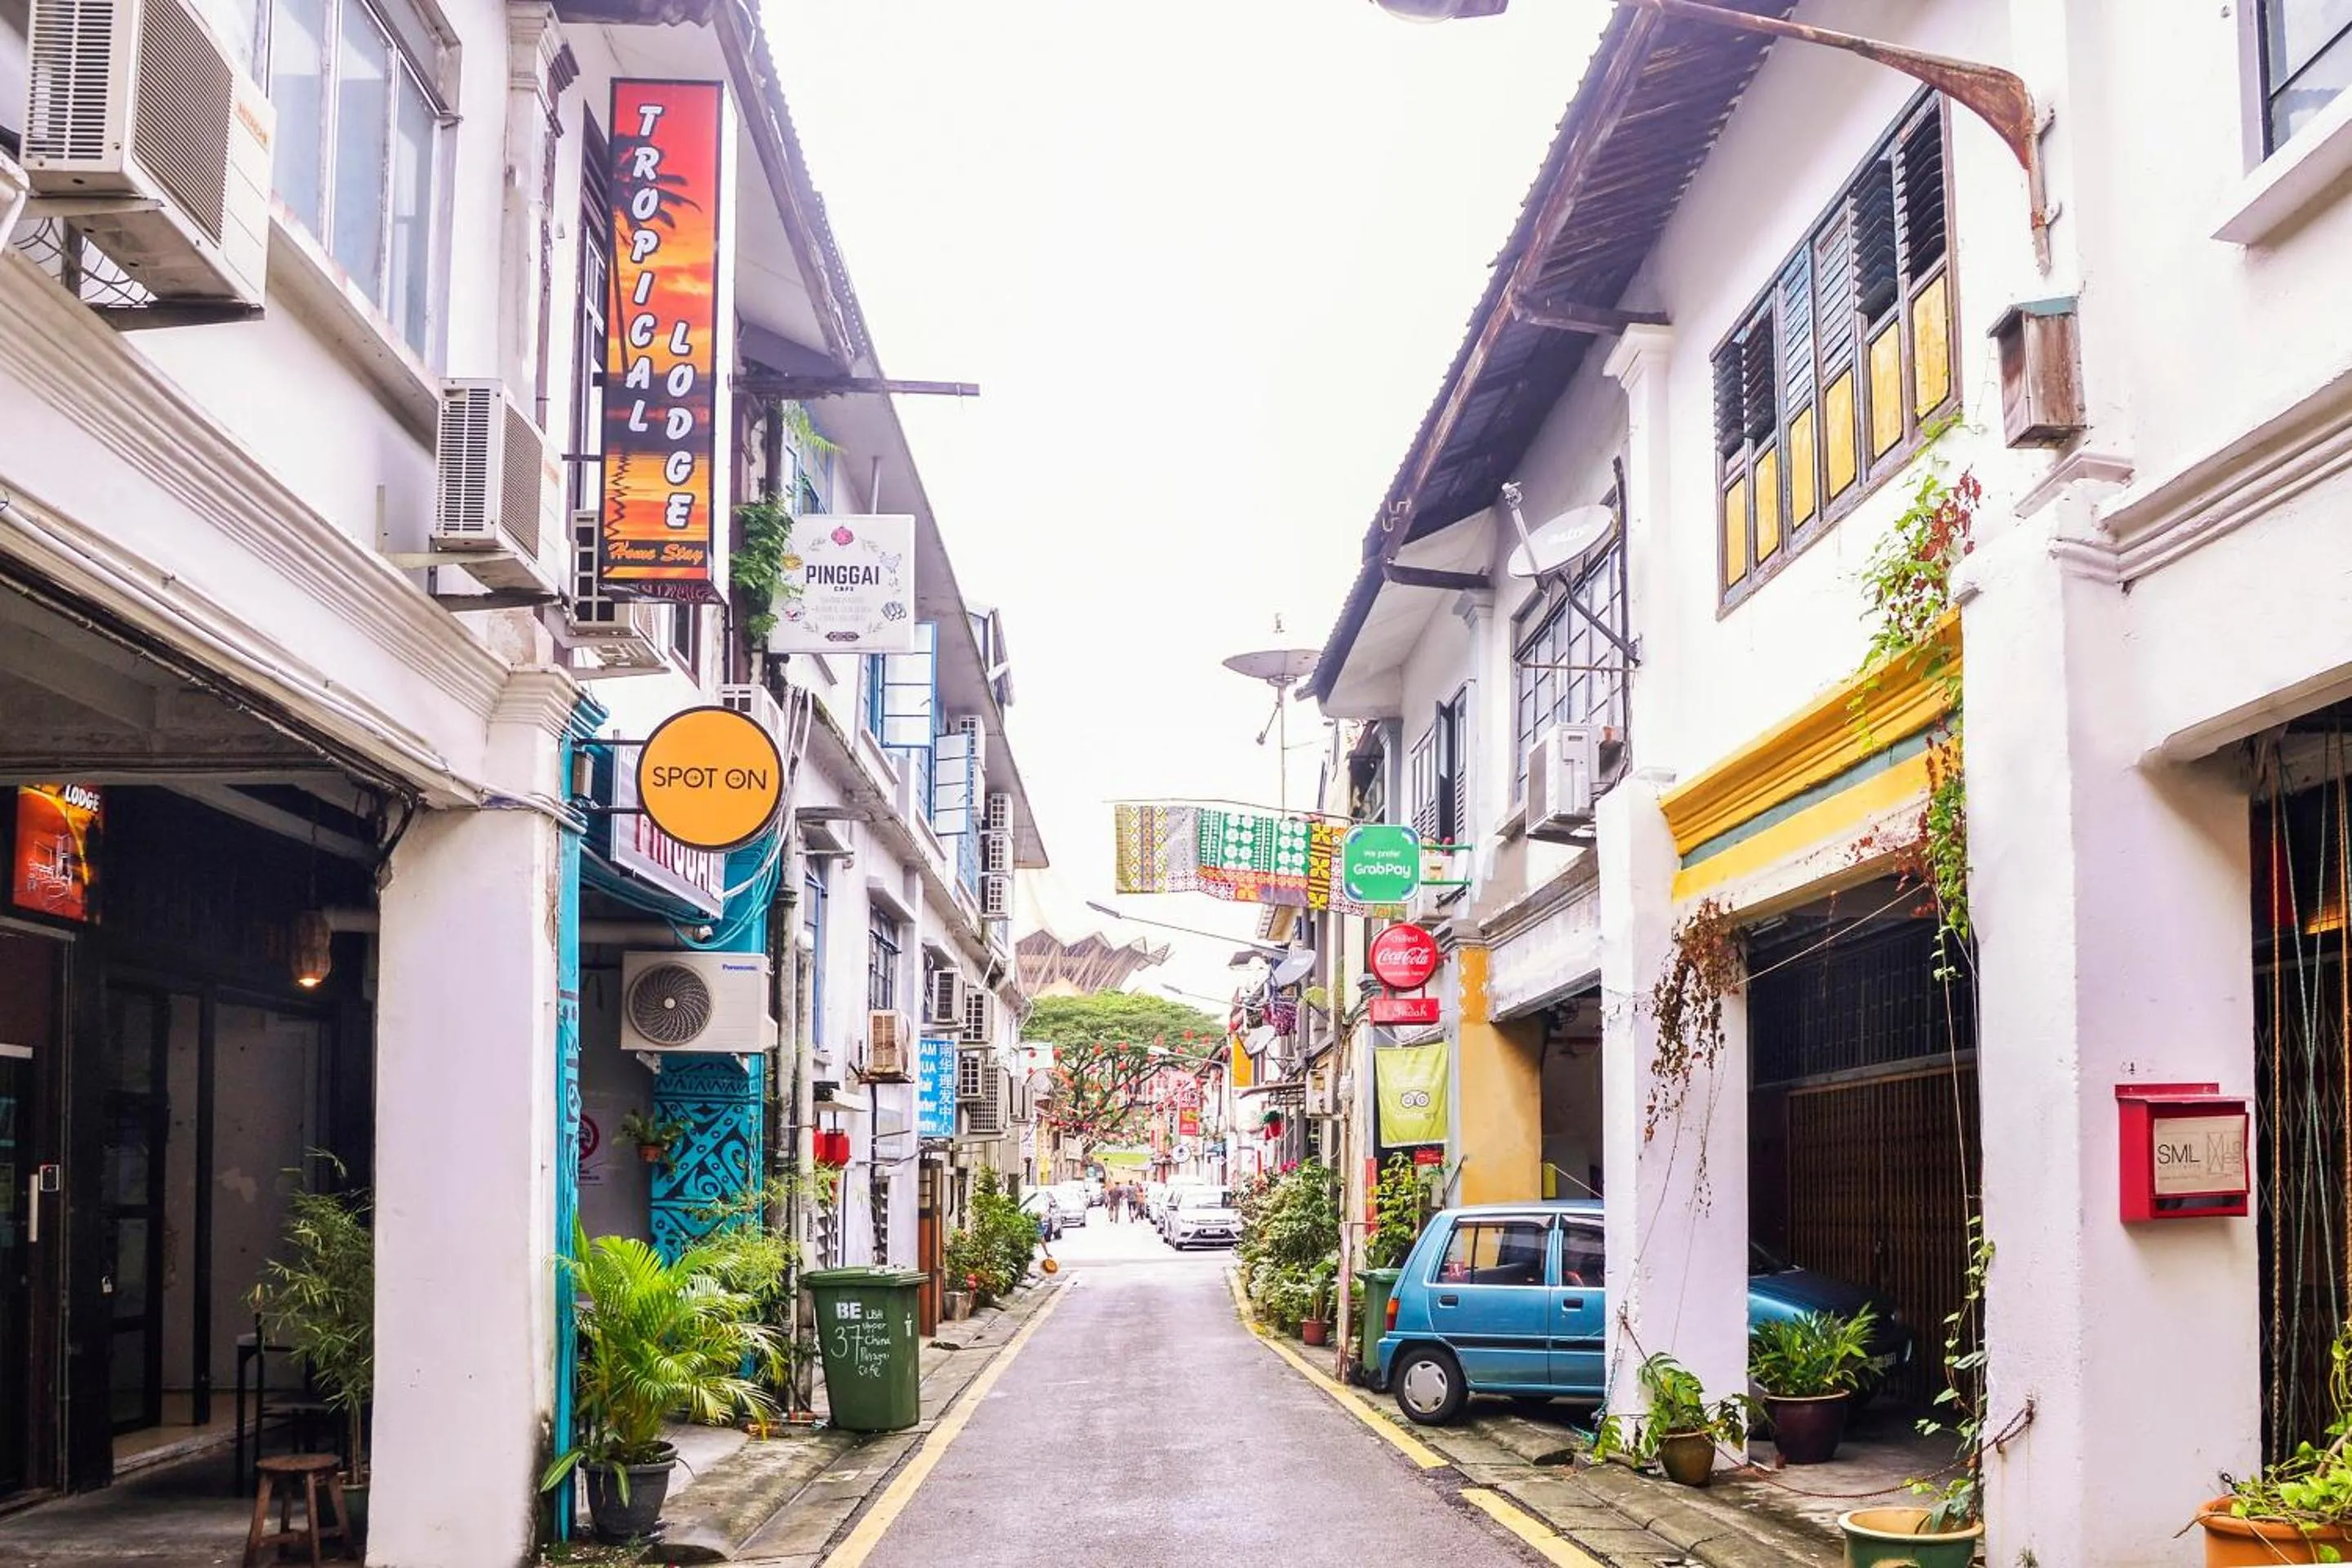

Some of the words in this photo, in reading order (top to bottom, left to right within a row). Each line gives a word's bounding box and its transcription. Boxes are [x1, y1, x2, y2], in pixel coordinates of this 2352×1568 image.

[625, 105, 663, 432] TROPICAL
[666, 322, 694, 527] LODGE
[608, 541, 656, 560] Home
[660, 542, 703, 565] Stay
[805, 565, 880, 586] PINGGAI
[653, 766, 719, 789] SPOT
[725, 768, 767, 791] ON
[65, 783, 100, 812] LODGE
[1378, 850, 1401, 858] prefer
[1353, 862, 1411, 879] GrabPay
[920, 1042, 937, 1055] AM
[2157, 1143, 2201, 1165] SML
[835, 1302, 862, 1320] BE
[831, 1324, 864, 1365] 37
